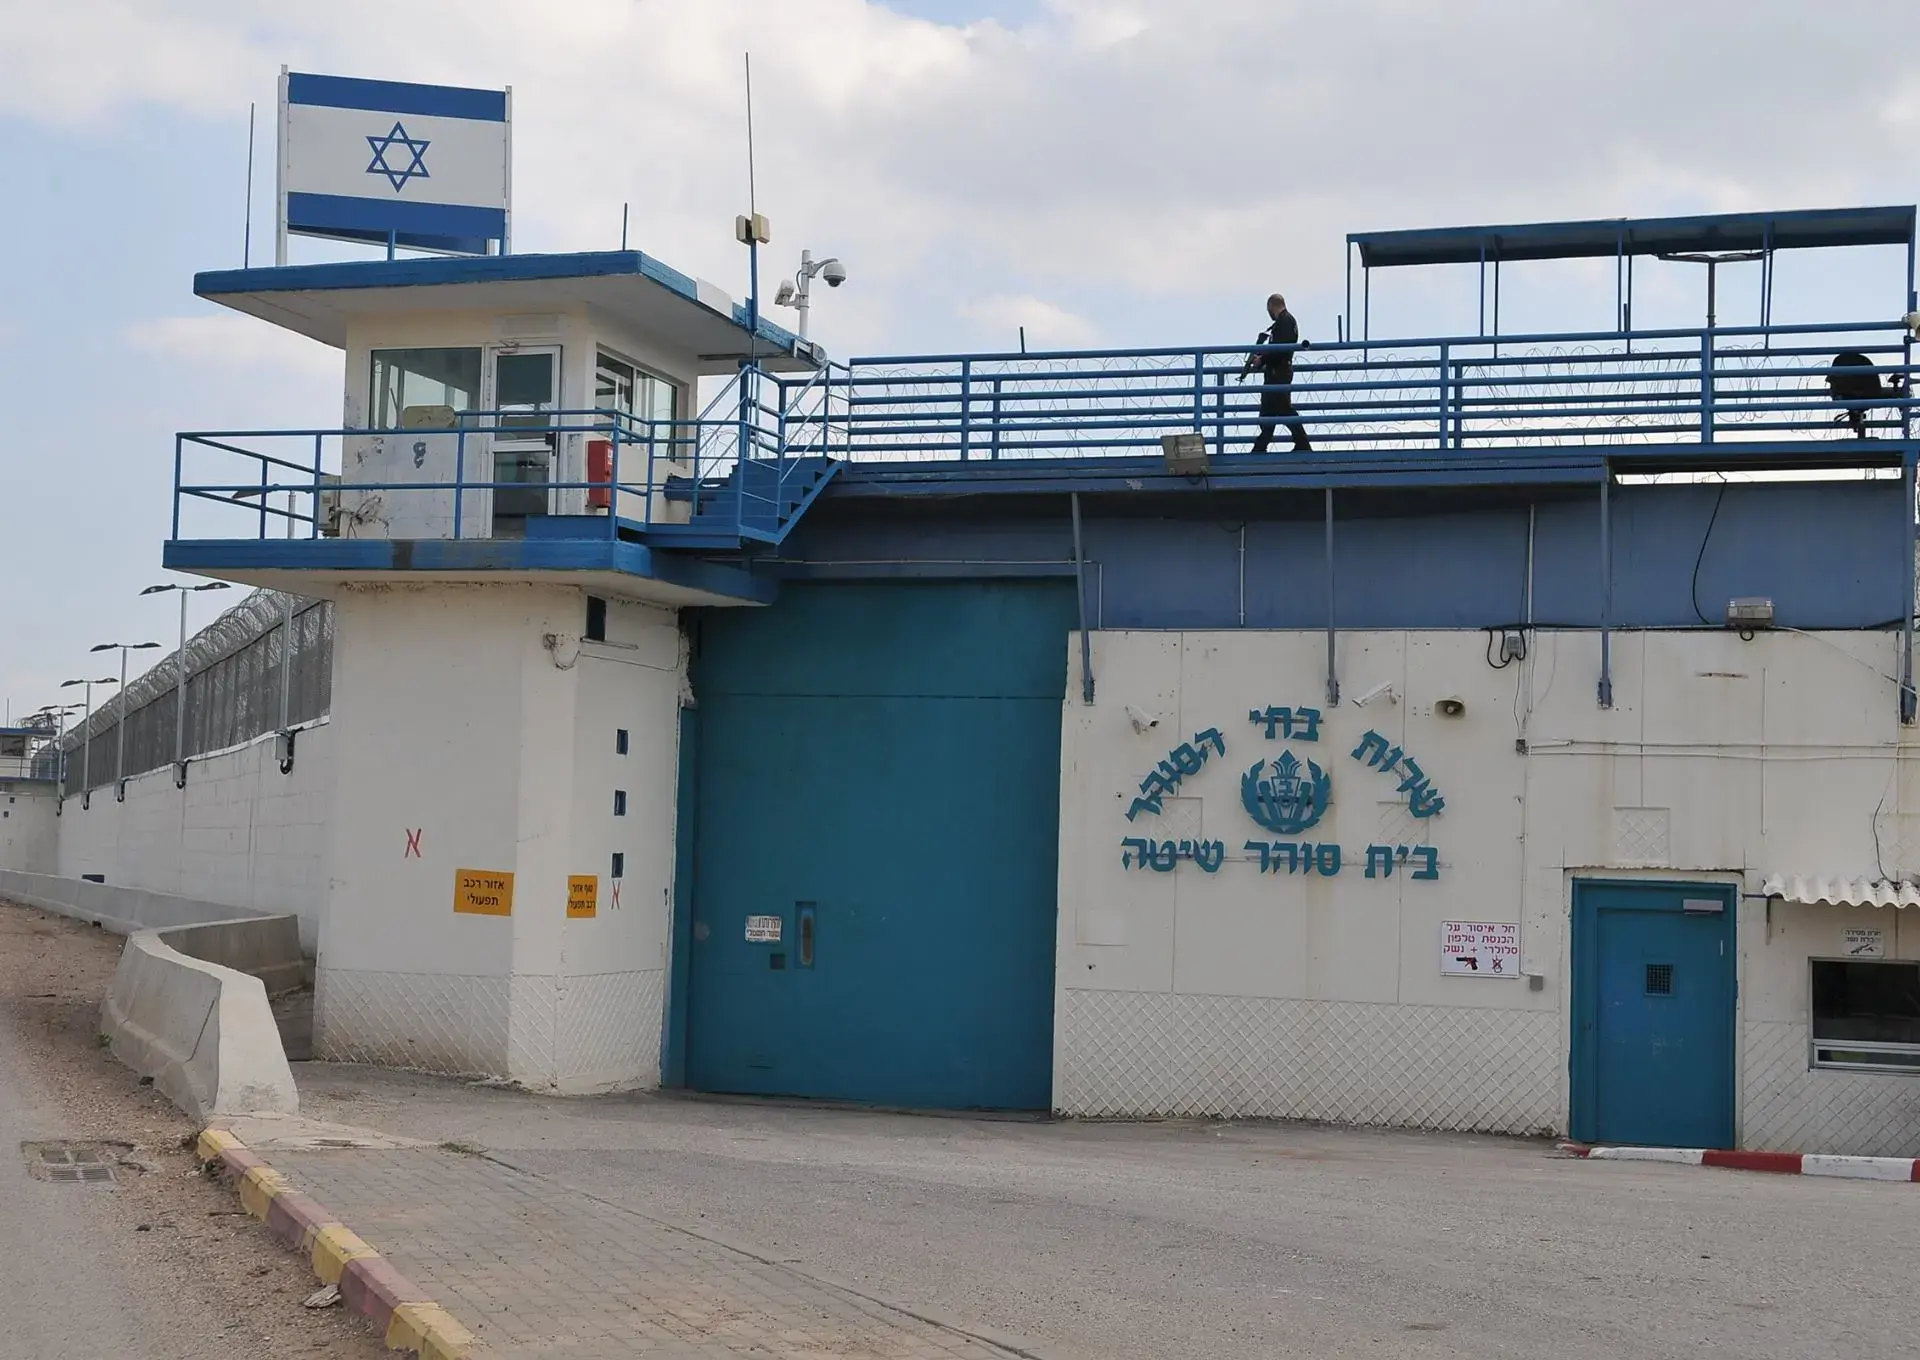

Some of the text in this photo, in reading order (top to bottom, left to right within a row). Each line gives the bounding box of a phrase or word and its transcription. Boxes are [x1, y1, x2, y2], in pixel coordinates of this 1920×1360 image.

[1248, 704, 1324, 742] בתי
[1125, 727, 1226, 823] הסוהר
[1350, 729, 1446, 818] שרות
[1121, 836, 1439, 880] בית סוהר שיטה
[463, 878, 505, 890] אזור רכב
[572, 884, 583, 893] אזור
[467, 893, 499, 906] תפעולי
[1446, 922, 1515, 933] חל איסור על
[1447, 934, 1514, 944] הכנסת טלפון
[1443, 945, 1464, 954] נשק
[1484, 946, 1518, 955] סלולרי
